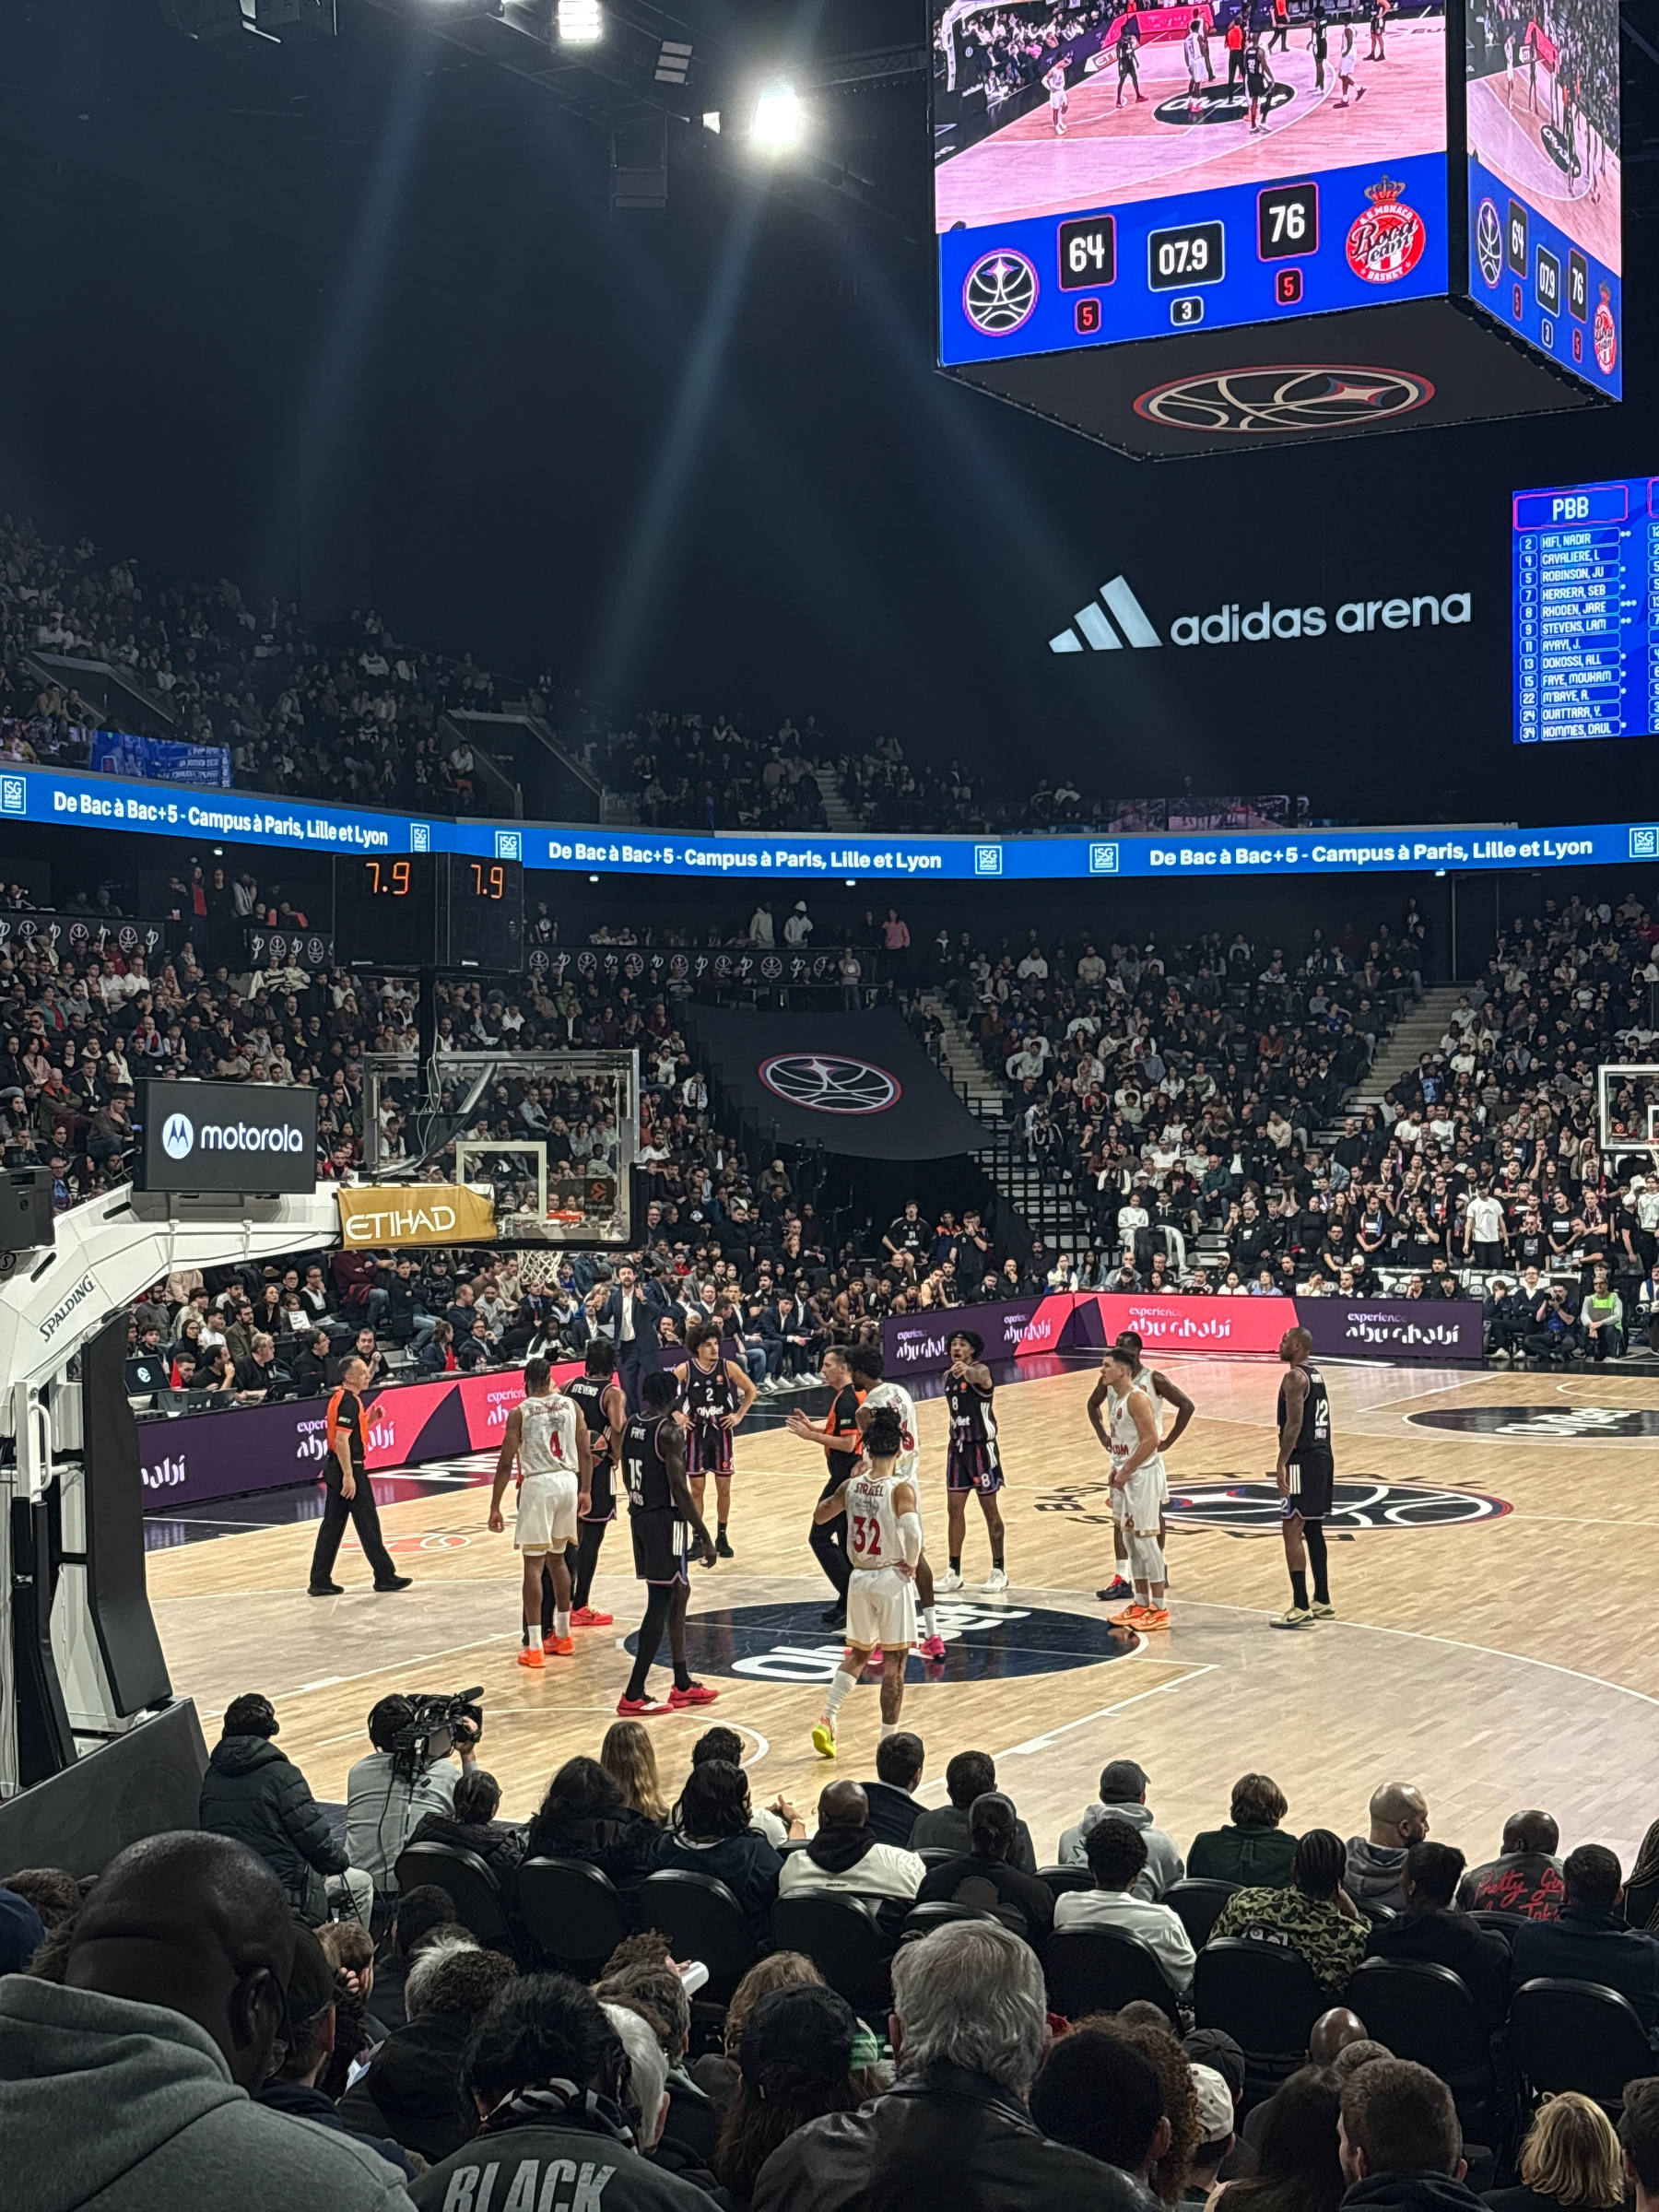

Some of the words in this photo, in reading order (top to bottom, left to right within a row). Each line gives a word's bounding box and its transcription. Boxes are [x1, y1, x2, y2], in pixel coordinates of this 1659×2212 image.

[1269, 203, 1305, 242] 76
[1512, 219, 1524, 260] 64
[1069, 234, 1105, 272] 64
[1159, 239, 1208, 275] 07.9
[1283, 276, 1295, 297] 5
[1539, 262, 1556, 299] 07.9
[1571, 267, 1584, 305] 76
[1082, 306, 1094, 326] 5
[1181, 301, 1193, 321] 3
[1552, 496, 1589, 521] PBB
[1524, 538, 1532, 550] 2
[1524, 555, 1532, 567] 4
[1524, 572, 1532, 583] 5
[1524, 590, 1532, 602] 7
[1171, 602, 1327, 646] adidas
[1335, 592, 1472, 633] arena
[1524, 606, 1533, 618] 8
[1524, 624, 1533, 635] 9
[1525, 641, 1533, 653] 11
[1524, 658, 1534, 670] 13
[1524, 676, 1535, 688] 15
[1523, 692, 1535, 704] 22
[1523, 710, 1536, 722] 24
[1523, 727, 1536, 739] 34
[4, 780, 22, 794] ISG
[53, 791, 77, 813] De
[79, 794, 112, 815] Bac
[113, 797, 124, 818] à
[127, 799, 178, 823] Bac+5
[188, 806, 251, 833] Campus
[253, 814, 263, 832] à
[265, 815, 304, 840] Paris,
[307, 819, 336, 841] Lille
[338, 827, 354, 842] et
[355, 829, 388, 848] Lyon
[415, 829, 427, 841] ISG
[500, 835, 517, 847] ISG
[1633, 831, 1654, 842] ISG
[548, 841, 572, 860] De
[575, 843, 606, 862] Bac
[608, 845, 619, 862] à
[621, 845, 675, 865] Bac+5
[684, 849, 758, 870] Campus
[760, 851, 771, 867] à
[775, 851, 827, 869] Paris,
[830, 851, 870, 868] Lille
[873, 853, 893, 869] et
[896, 852, 942, 873] Lyon
[979, 849, 998, 860] ISG
[1094, 847, 1114, 858] ISG
[1149, 850, 1177, 866] De
[1180, 849, 1217, 865] Bac
[1219, 848, 1231, 865] à
[1235, 846, 1299, 865] Bac+5
[1312, 845, 1394, 865] Campus
[1397, 844, 1409, 860] à
[1414, 841, 1468, 862] Paris,
[1473, 841, 1516, 859] Lille
[1519, 841, 1541, 858] et
[1543, 838, 1593, 860] Lyon
[366, 862, 410, 895] 7.9
[470, 864, 504, 900] 7.9
[200, 1122, 303, 1152] motorola
[346, 1206, 456, 1241] ETIHAD
[39, 1274, 94, 1343] SPALDING
[1347, 1311, 1407, 1324] experience
[571, 1383, 599, 1397] STEVENS
[705, 1387, 714, 1402] 2
[951, 1396, 959, 1411] 8
[297, 1416, 327, 1434] experi
[630, 1426, 646, 1441] FAYE
[549, 1430, 564, 1460] 4
[628, 1458, 643, 1490] 15
[980, 1473, 991, 1488] 8
[853, 1515, 881, 1556] 32
[1474, 1870, 1528, 1909] Pretty
